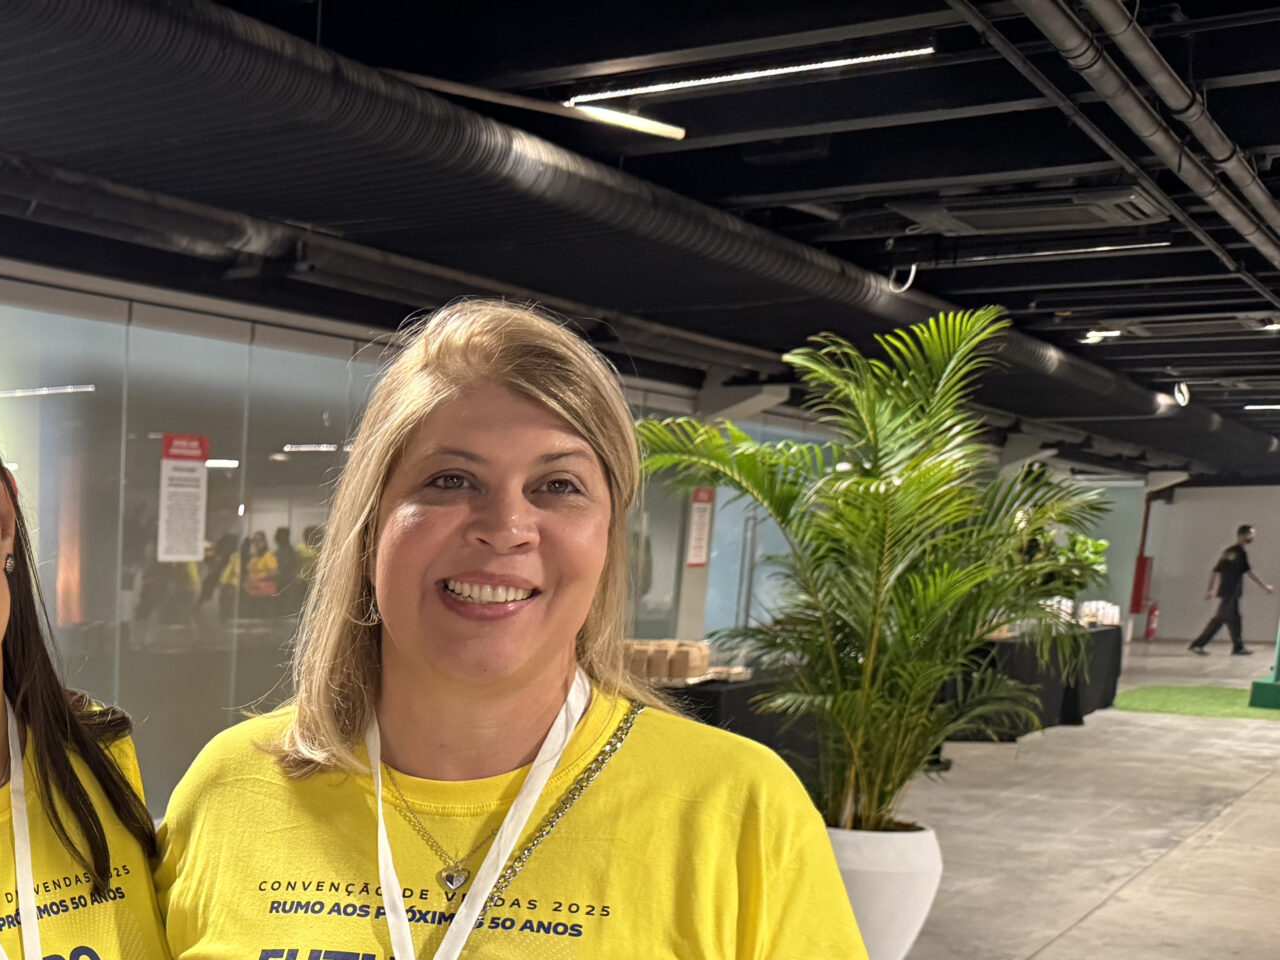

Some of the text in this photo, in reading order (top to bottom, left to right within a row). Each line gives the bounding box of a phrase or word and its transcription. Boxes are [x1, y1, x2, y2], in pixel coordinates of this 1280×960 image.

[33, 871, 92, 895] VENDAS
[70, 894, 88, 911] 50
[90, 886, 126, 905] ANOS
[258, 880, 611, 917] CONVENÇÃO DE VDAS 2025
[268, 900, 325, 914] RUMO
[327, 902, 371, 918] AOS
[488, 916, 516, 930] 50
[519, 919, 583, 937] ANOS
